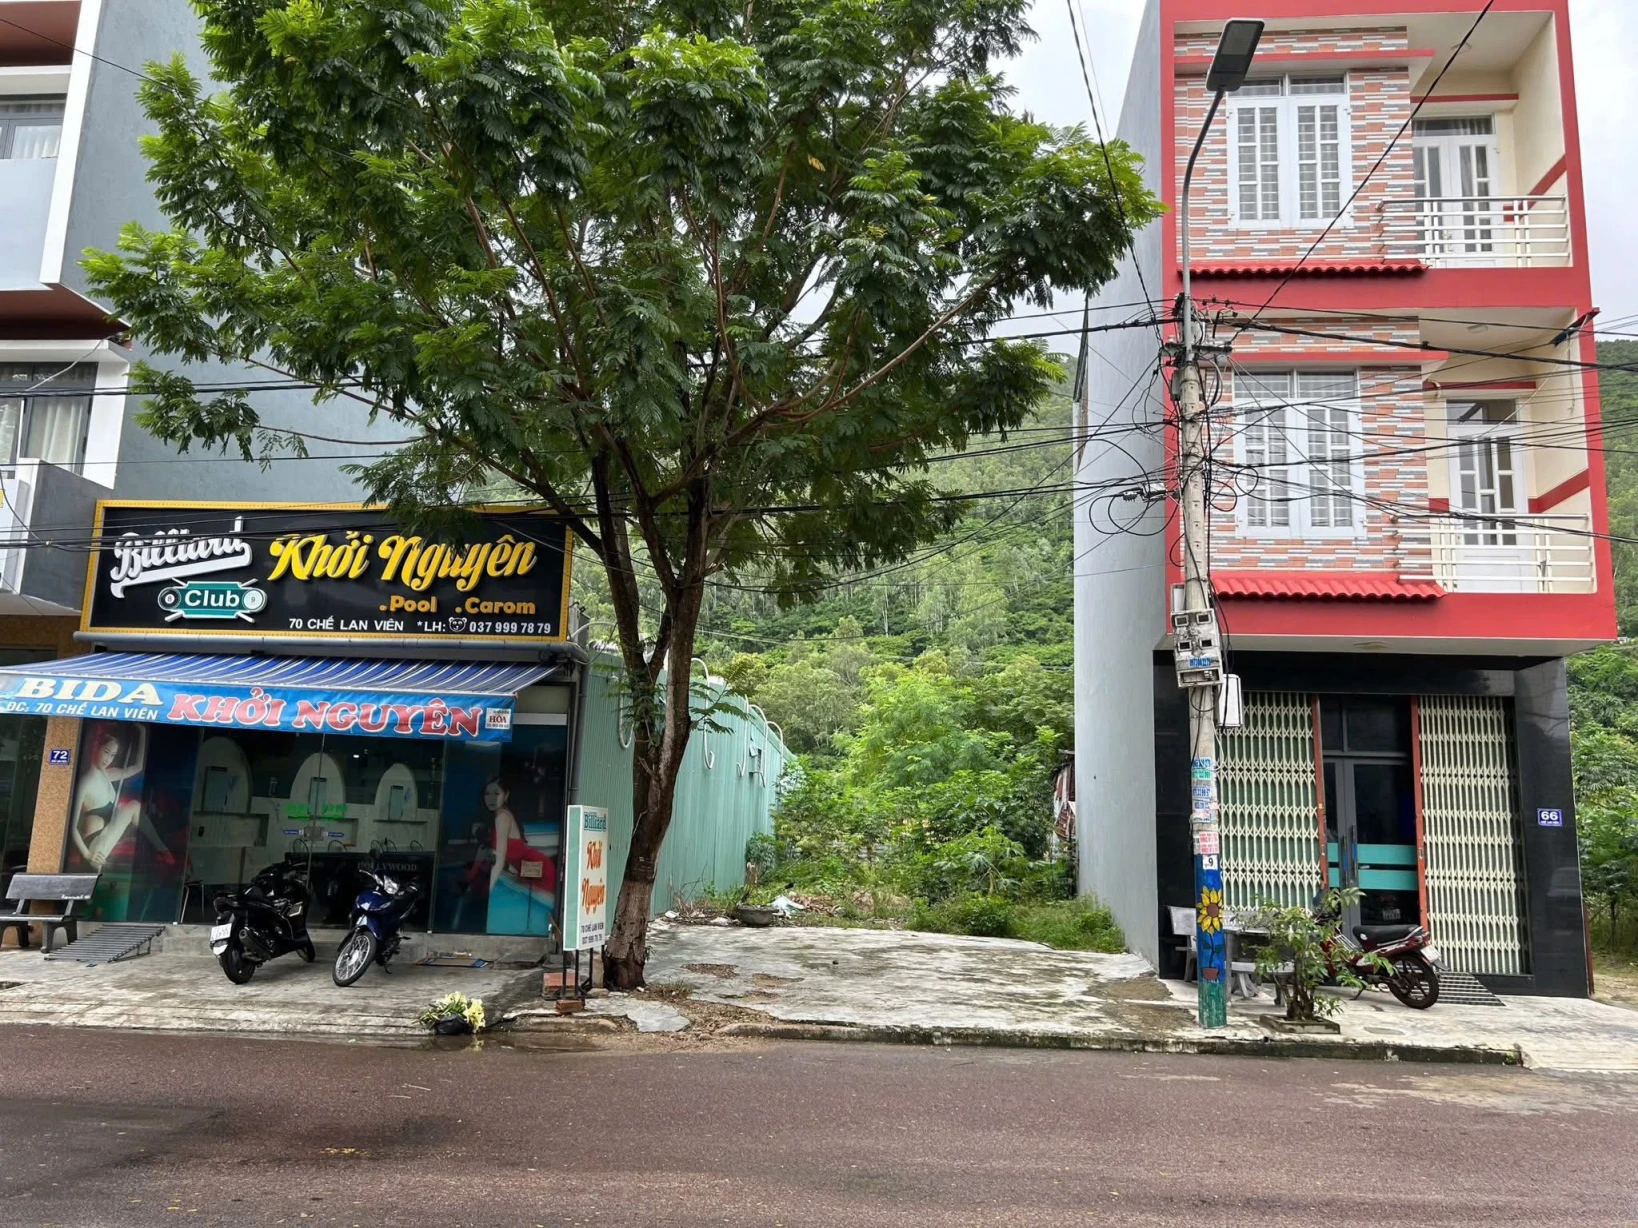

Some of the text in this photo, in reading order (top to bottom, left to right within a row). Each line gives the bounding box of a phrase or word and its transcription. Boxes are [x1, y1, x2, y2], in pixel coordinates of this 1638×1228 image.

[110, 515, 253, 586] Billiard
[267, 530, 537, 592] Khởi Nguyên
[184, 589, 241, 608] Club
[289, 618, 303, 629] 70
[307, 615, 335, 630] CHẾ
[340, 620, 368, 631] LAN
[374, 618, 404, 631] VIÊN
[469, 621, 492, 633] 037
[495, 622, 518, 634] 999
[520, 622, 535, 634] 78
[537, 622, 551, 634] 79
[14, 677, 164, 706] BIDA
[6, 702, 158, 720] ĐC: 70 CHẾ LAN VIÊN
[167, 687, 483, 737] KHỞI NGUYÊN
[53, 750, 68, 760] 72
[584, 812, 607, 832] Billiard
[1541, 811, 1559, 821] 66
